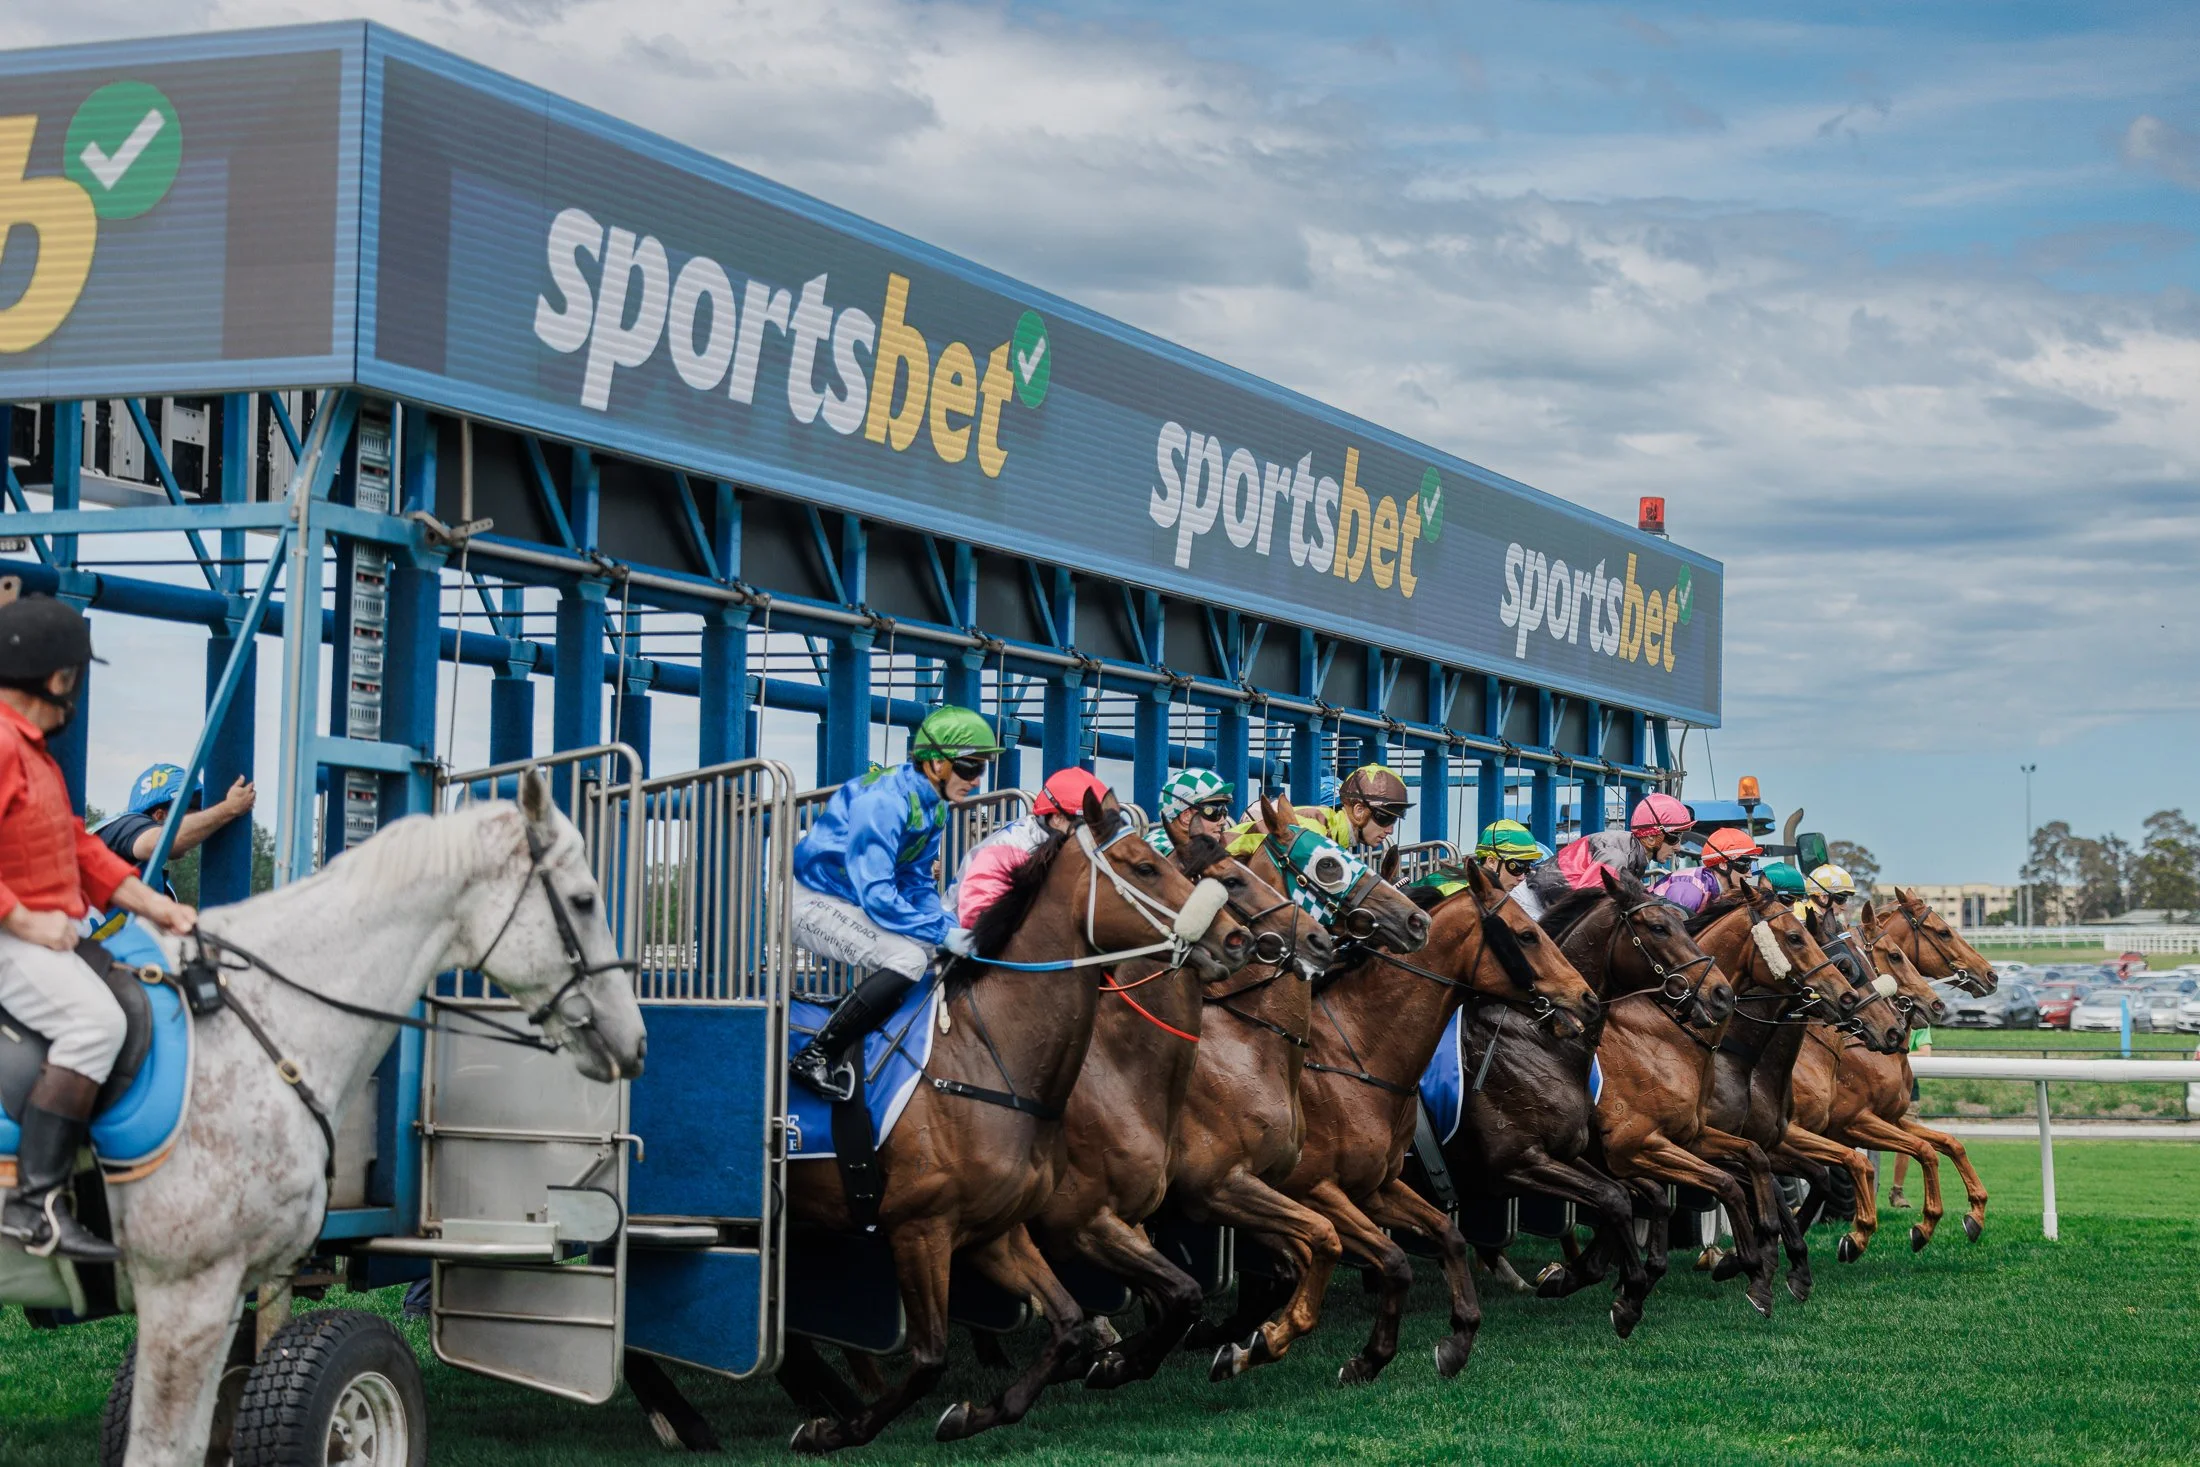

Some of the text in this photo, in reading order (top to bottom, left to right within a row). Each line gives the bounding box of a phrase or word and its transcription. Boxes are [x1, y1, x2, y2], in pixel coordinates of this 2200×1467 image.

[534, 208, 1014, 478] sportsbet
[1150, 421, 1421, 599] sportsbet
[1500, 542, 1679, 673] sportsbet
[141, 770, 168, 795] sb
[832, 908, 850, 925] THE
[849, 920, 880, 942] TRACK
